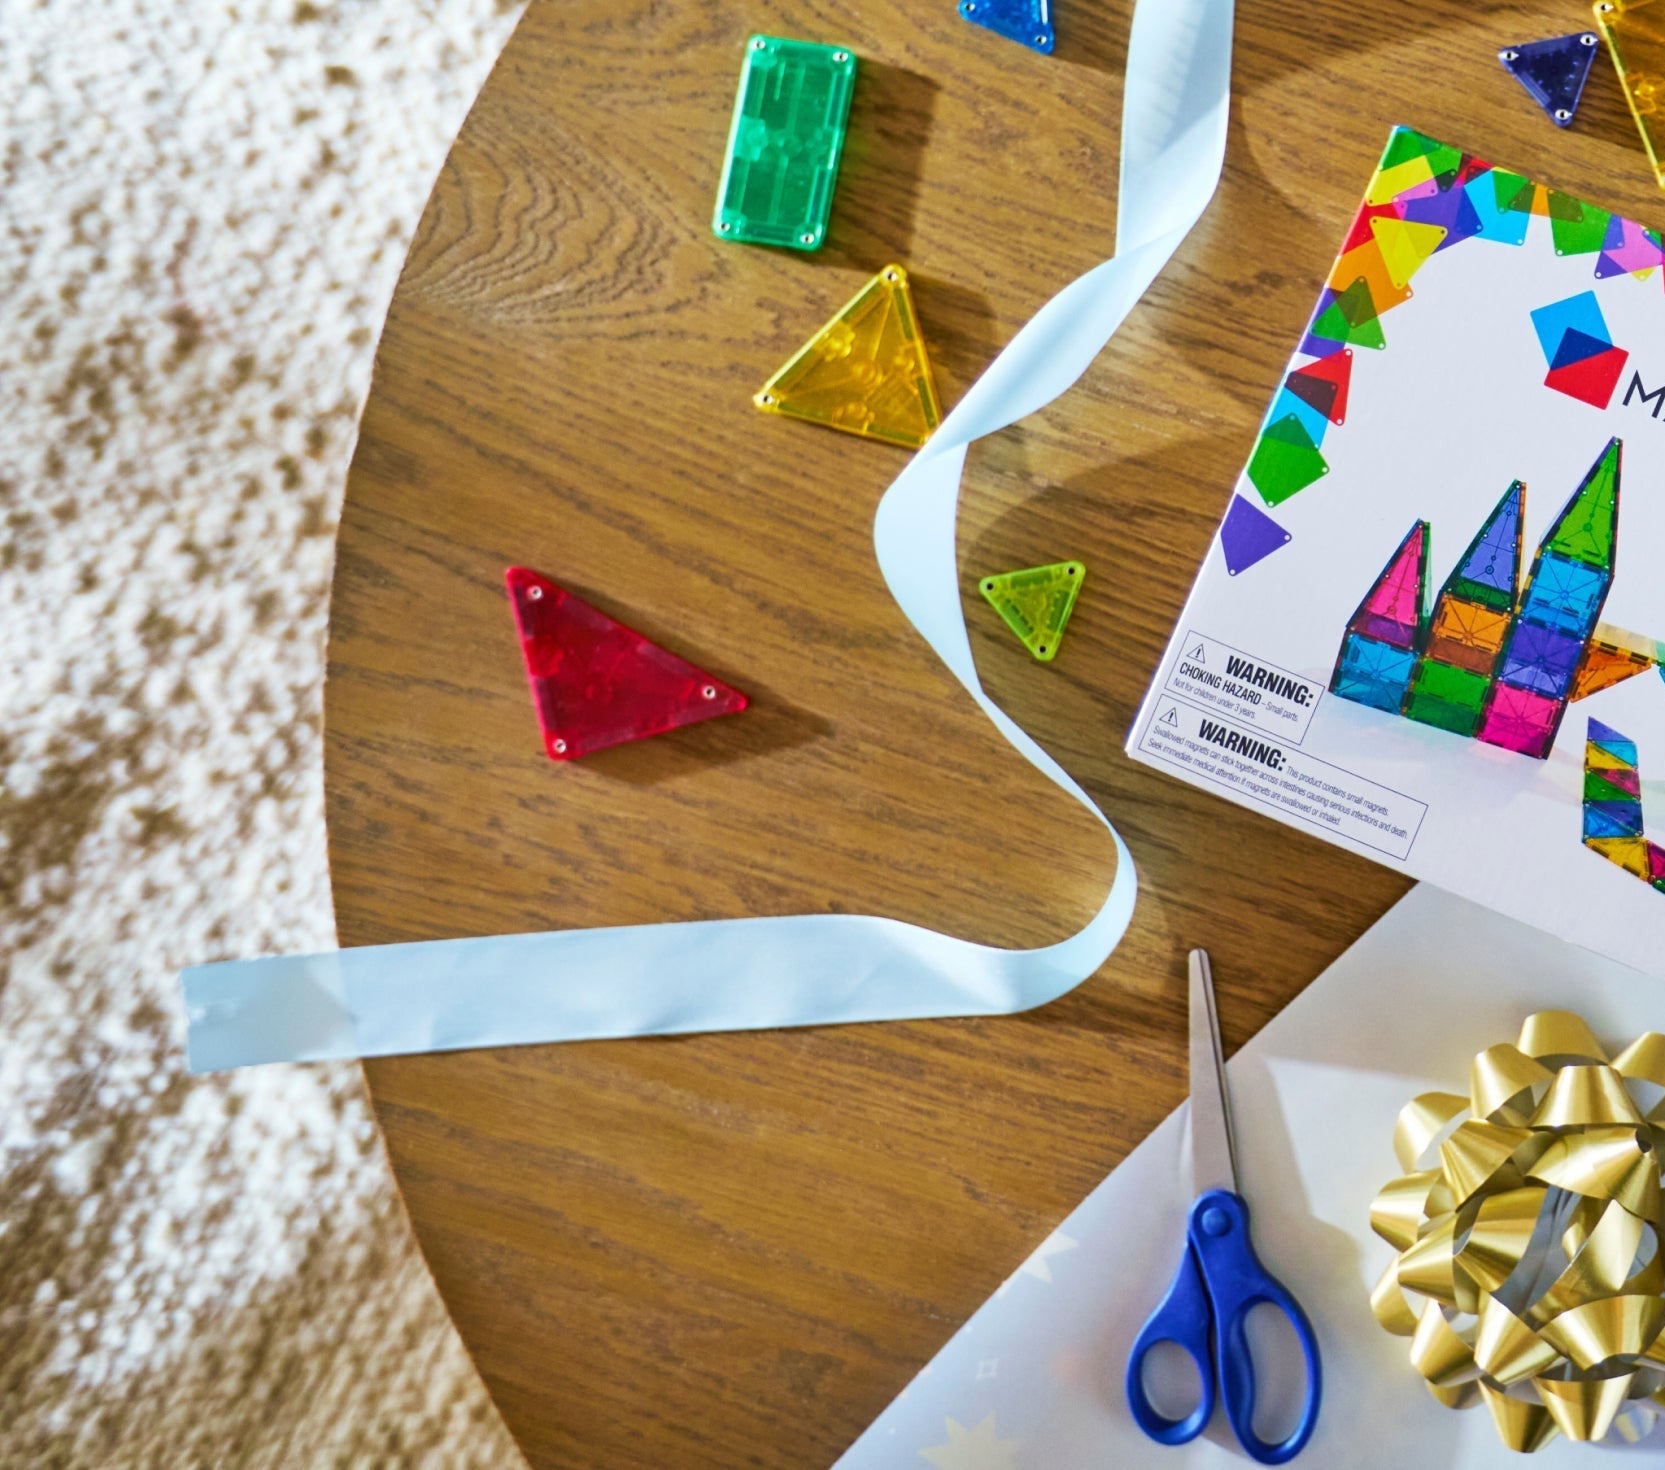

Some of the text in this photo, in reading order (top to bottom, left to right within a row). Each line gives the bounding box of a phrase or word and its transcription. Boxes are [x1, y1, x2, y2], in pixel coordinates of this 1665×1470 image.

[1172, 677, 1186, 689] Not
[1184, 682, 1194, 692] for
[1194, 688, 1216, 702] children
[1216, 698, 1235, 709] under
[1180, 662, 1222, 689] CHOKING
[1222, 680, 1262, 705] HAZARD
[1266, 702, 1284, 715] Small
[1226, 655, 1314, 708] WARNING:
[1148, 738, 1162, 750] Seek
[1162, 746, 1193, 763] immediate
[1193, 758, 1216, 773] medical
[1215, 768, 1241, 783] attention
[1245, 781, 1271, 796] magnets
[1270, 790, 1281, 801] are
[1280, 796, 1312, 813] swallowed
[1311, 807, 1320, 816] or
[1153, 725, 1185, 744] Swallowed
[1184, 740, 1210, 756] magnets
[1210, 751, 1221, 760] can
[1220, 756, 1235, 766] stick
[1235, 760, 1260, 776] together
[1259, 772, 1284, 786] across
[1279, 780, 1306, 796] intestines
[1306, 792, 1329, 808] causing
[1329, 801, 1351, 815] serious
[1351, 810, 1379, 826] infections
[1378, 822, 1391, 832] and
[1198, 719, 1287, 772] WARNING:
[1287, 766, 1299, 778] This
[1298, 774, 1322, 788] product
[1322, 783, 1346, 798] contains
[1346, 793, 1364, 804] small
